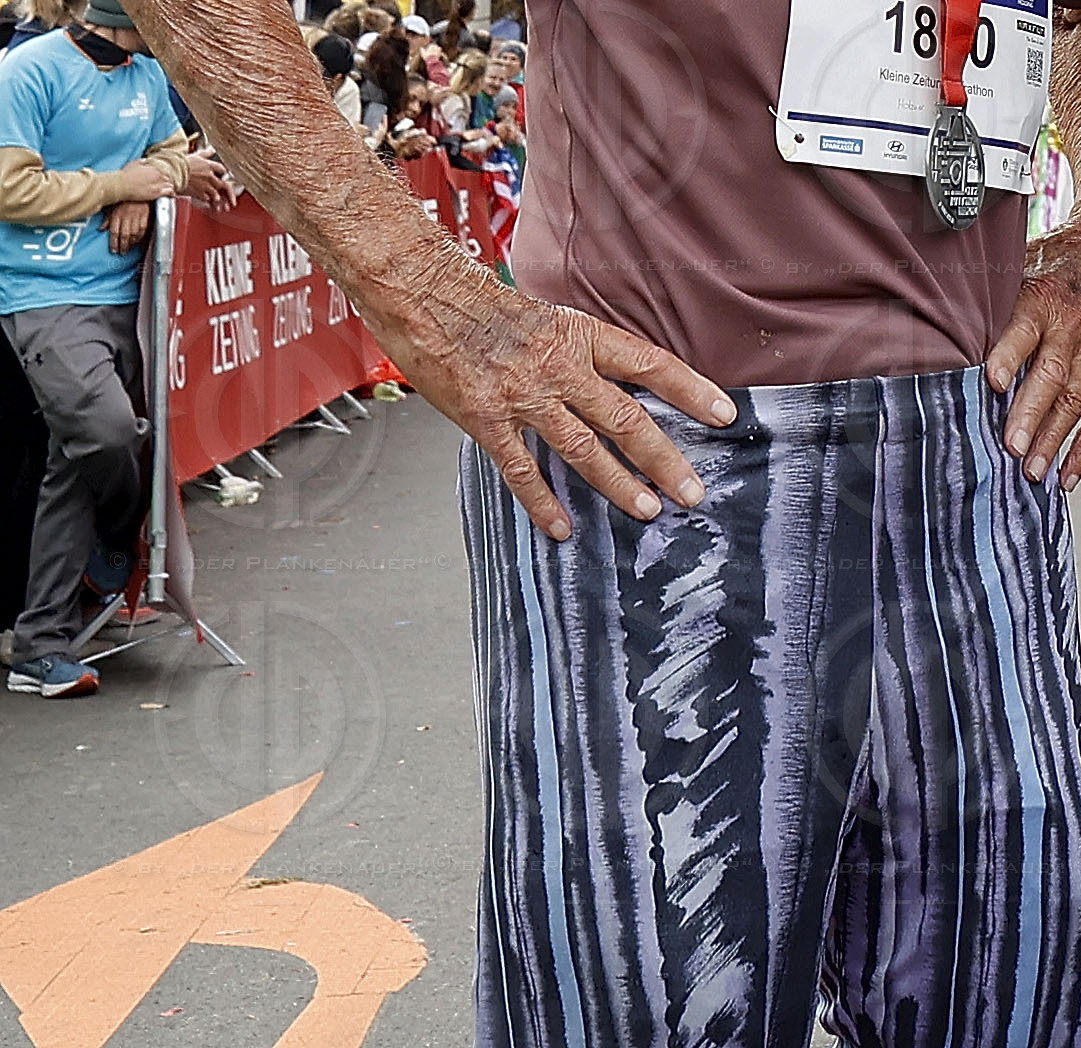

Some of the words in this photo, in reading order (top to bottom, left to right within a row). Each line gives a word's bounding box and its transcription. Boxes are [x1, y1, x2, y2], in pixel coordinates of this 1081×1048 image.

[885, 0, 996, 69] 180
[879, 68, 910, 84] Kleine
[912, 73, 941, 89] Zeitun
[964, 83, 994, 98] rathon
